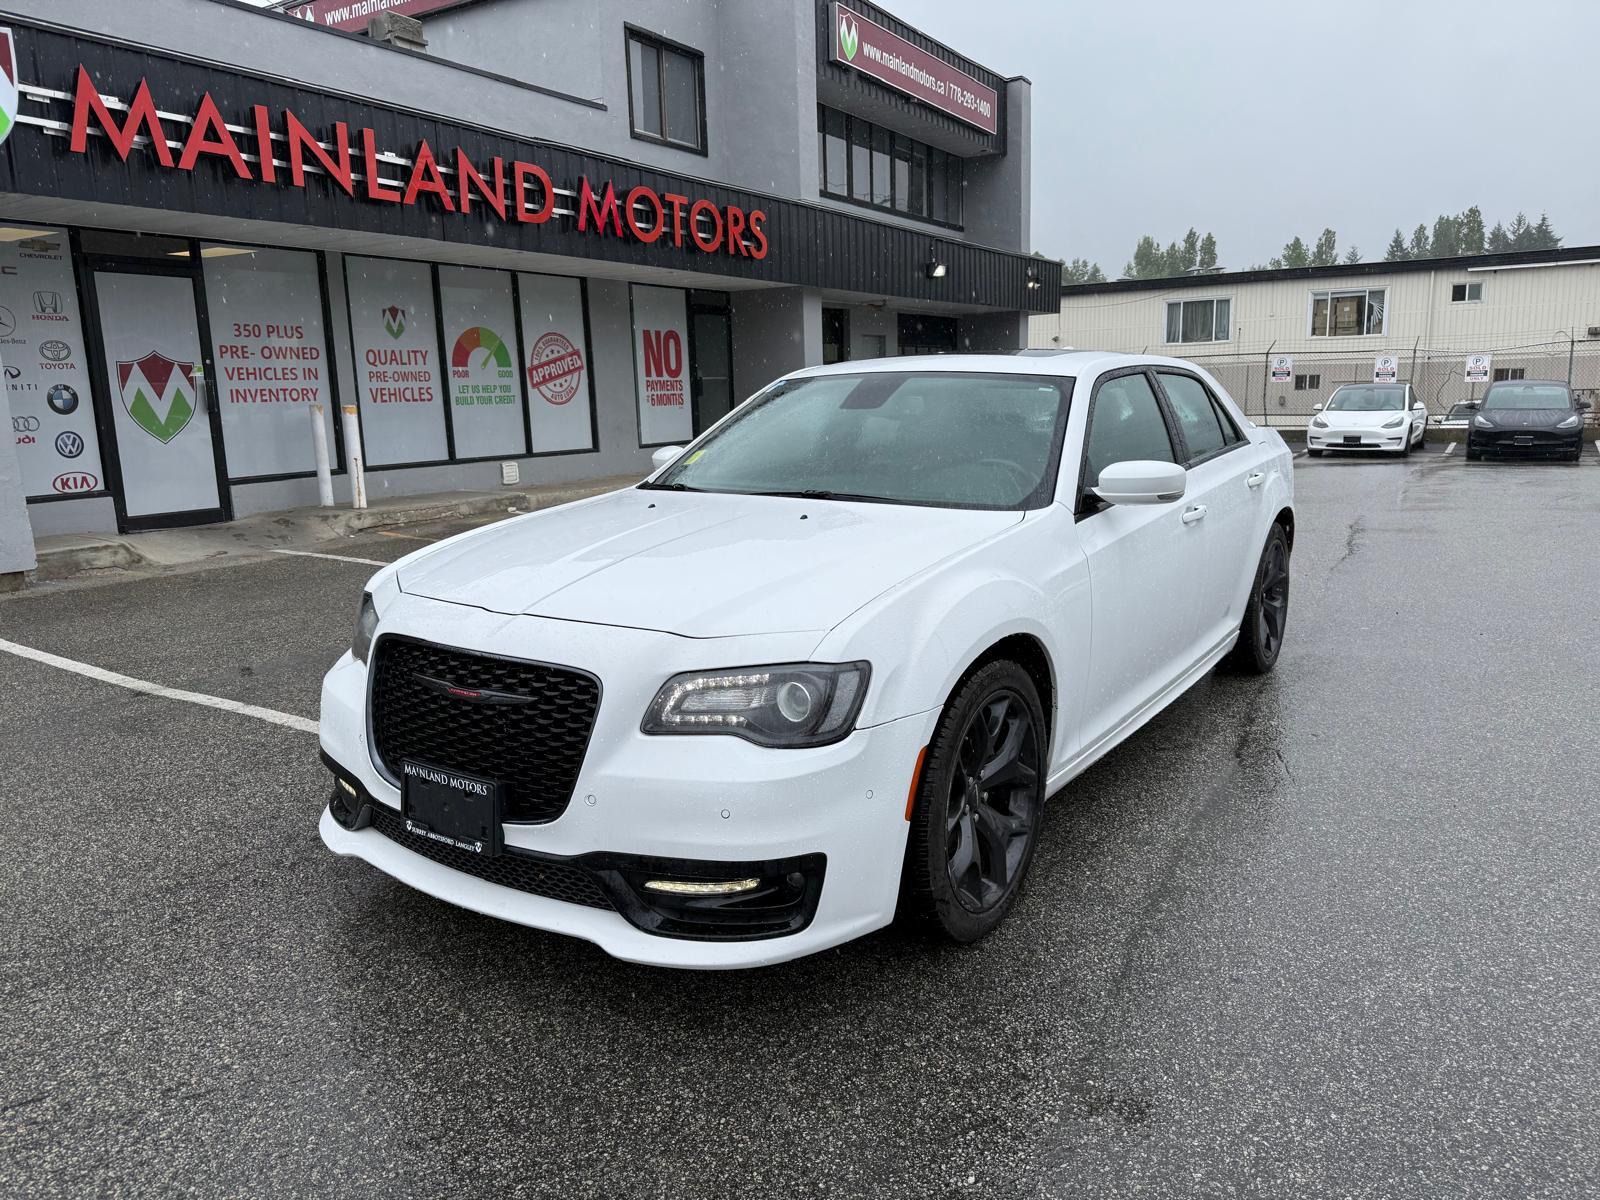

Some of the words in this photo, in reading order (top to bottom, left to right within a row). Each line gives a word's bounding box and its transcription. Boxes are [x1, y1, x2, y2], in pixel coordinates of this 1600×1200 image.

[862, 41, 945, 97] www.mainlandmotors.ca
[70, 63, 553, 223] MAINLAND
[578, 174, 768, 260] MOTORS
[19, 252, 63, 261] CHEVROLET
[31, 314, 70, 322] HONDA
[233, 323, 262, 339] 350
[266, 325, 304, 340] PLUS
[219, 345, 256, 360] PRE-
[260, 346, 320, 360] OWNED
[365, 349, 428, 367] QUALITY
[642, 329, 682, 379] NO
[224, 367, 298, 381] VEHICLES
[303, 367, 319, 381] IN
[368, 371, 431, 382] PRE-OWNED
[452, 370, 470, 379] POOR
[498, 369, 513, 378] GOOD
[532, 355, 582, 384] APPROVED
[458, 385, 469, 394] LET
[471, 385, 480, 394] US
[482, 385, 497, 394] HELP
[498, 384, 512, 393] YOU
[646, 380, 683, 392] PAYMENTS
[230, 388, 319, 403] INVENTORY
[369, 386, 434, 403] VEHICLES
[455, 396, 474, 406] BUILD
[475, 395, 493, 405] YOUR
[494, 395, 516, 405] CREDIT
[650, 393, 656, 406] 6
[656, 393, 684, 406] MONTHS
[404, 763, 448, 785] MAINLAND
[450, 777, 488, 796] MOTORS
